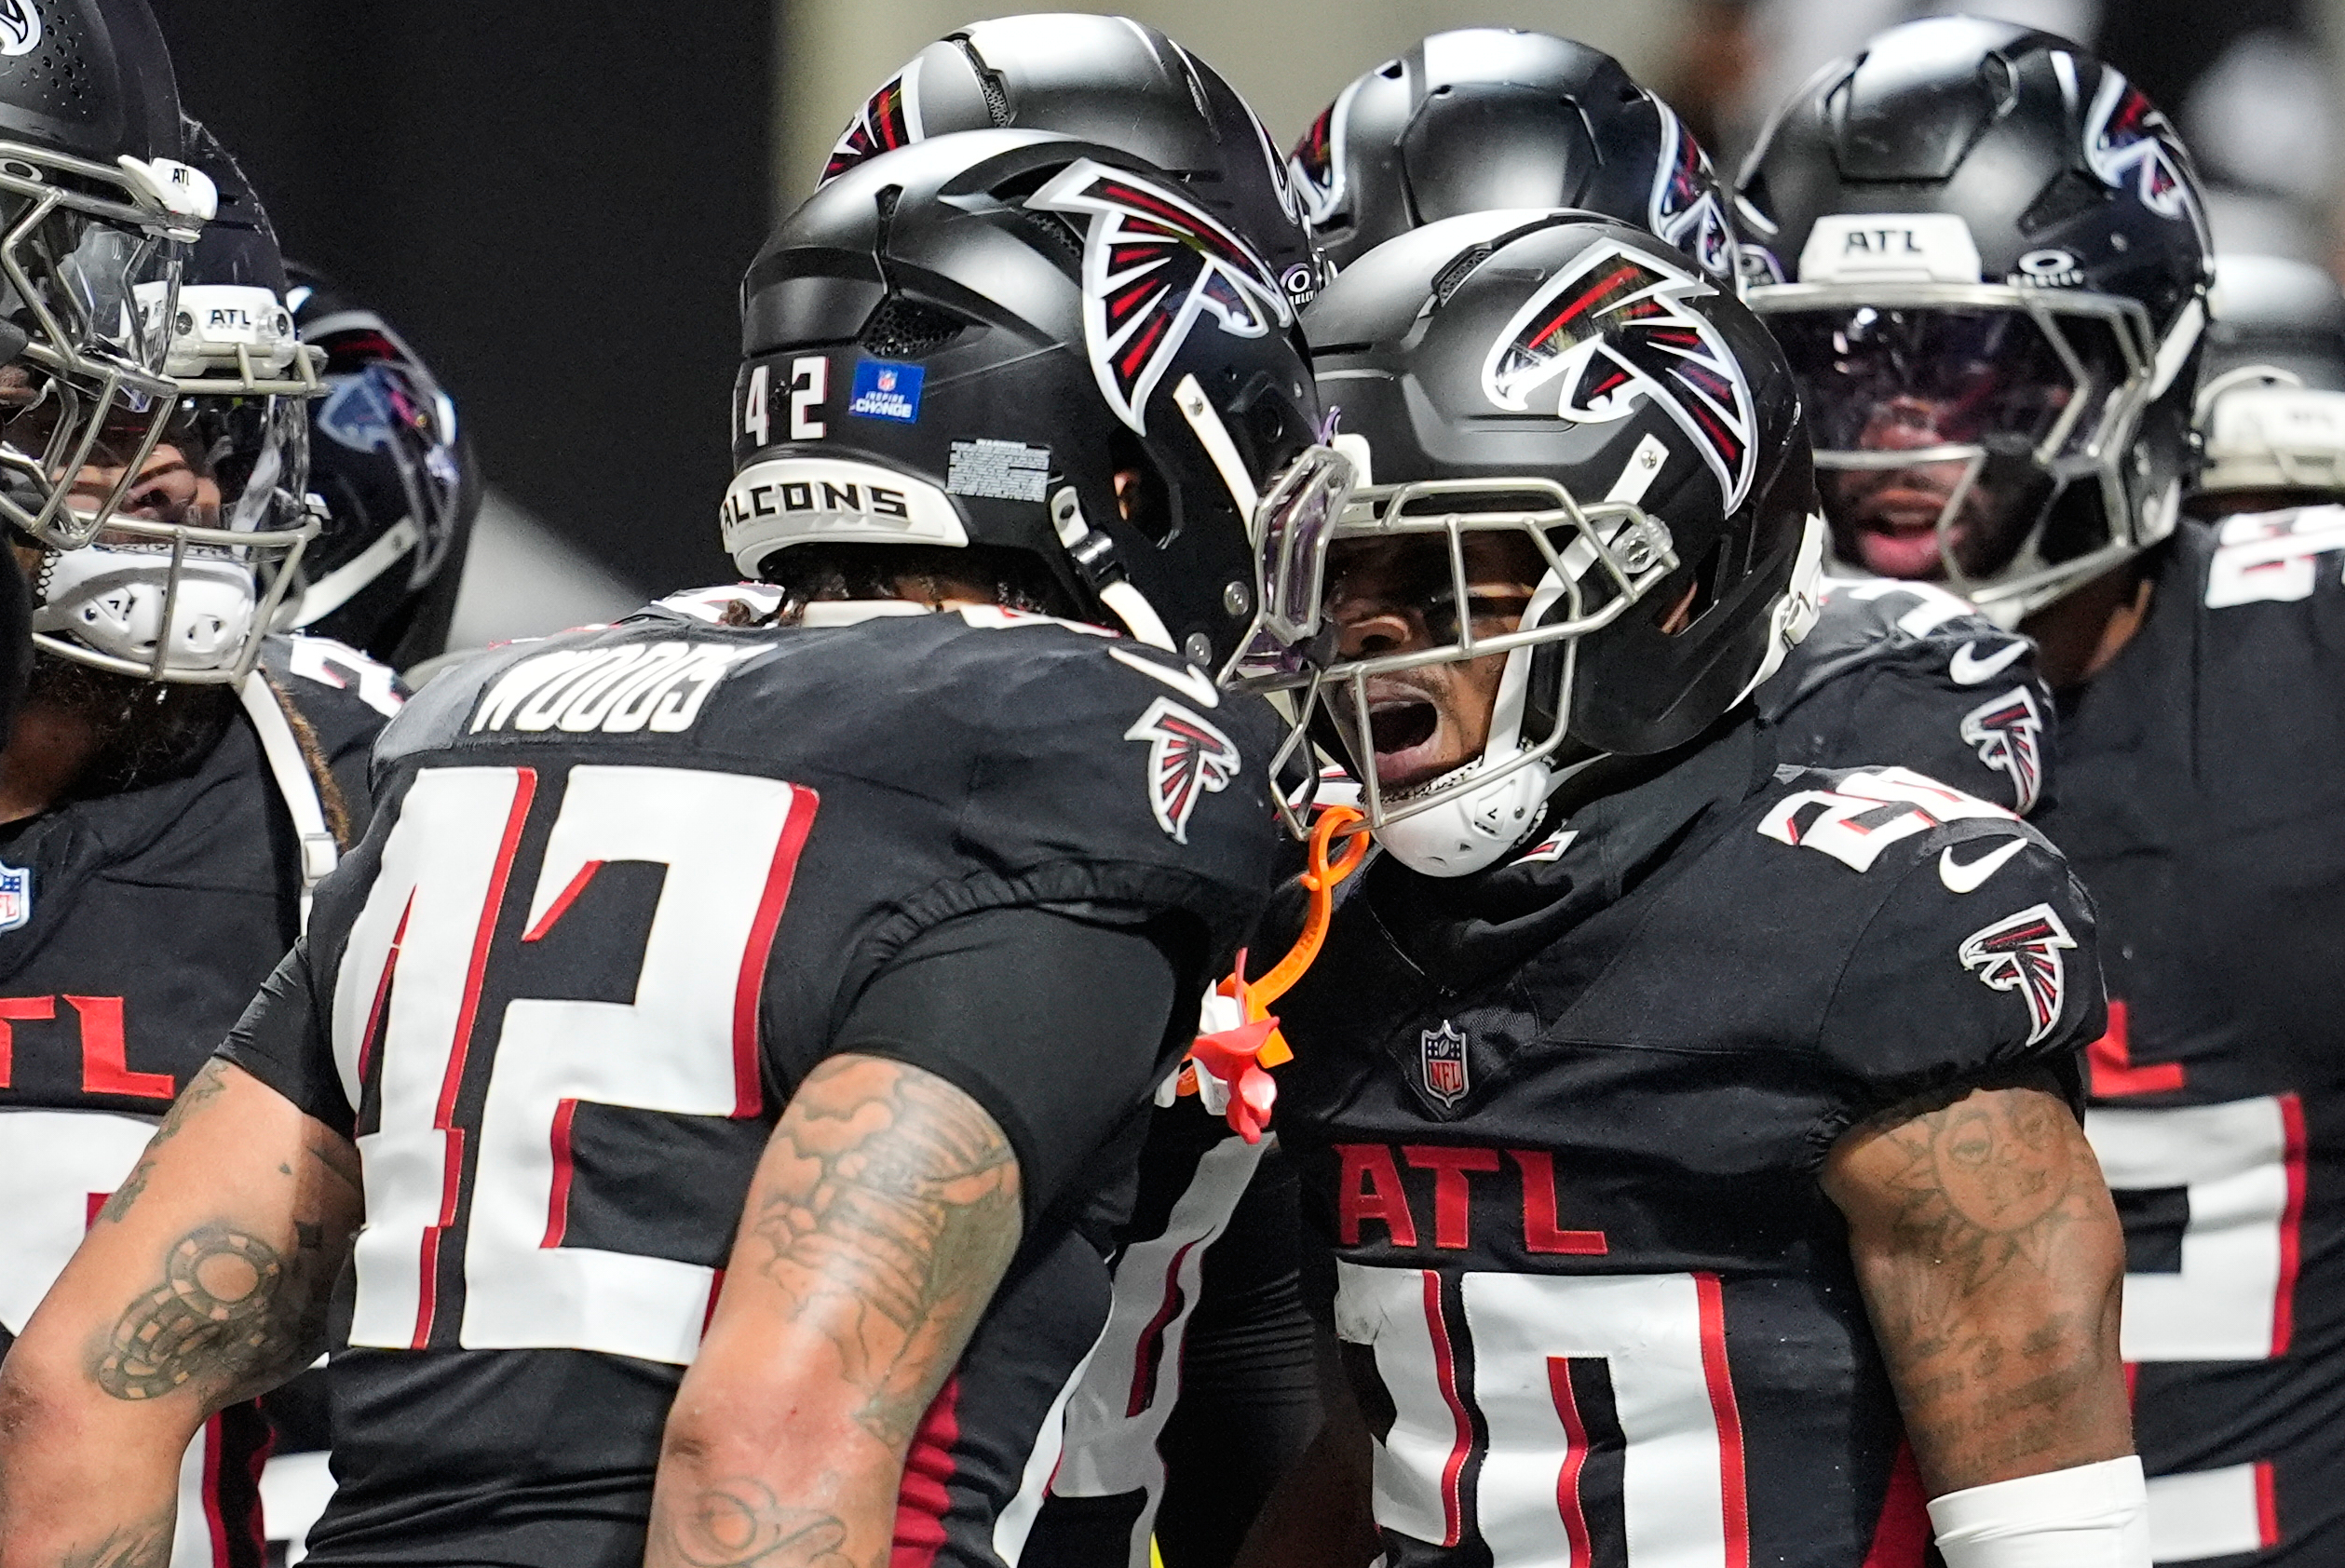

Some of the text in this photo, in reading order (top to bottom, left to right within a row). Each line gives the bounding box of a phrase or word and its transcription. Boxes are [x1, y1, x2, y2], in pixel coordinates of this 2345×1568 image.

[1843, 228, 1923, 257] ATL
[209, 308, 251, 326] ATL
[746, 356, 830, 447] 42
[855, 398, 913, 419] CHANGE
[721, 480, 909, 536] ALCONS
[468, 642, 778, 735] WOODS
[332, 764, 820, 1366] 42
[1429, 1061, 1463, 1093] NFL
[1333, 1143, 1608, 1255] ATL
